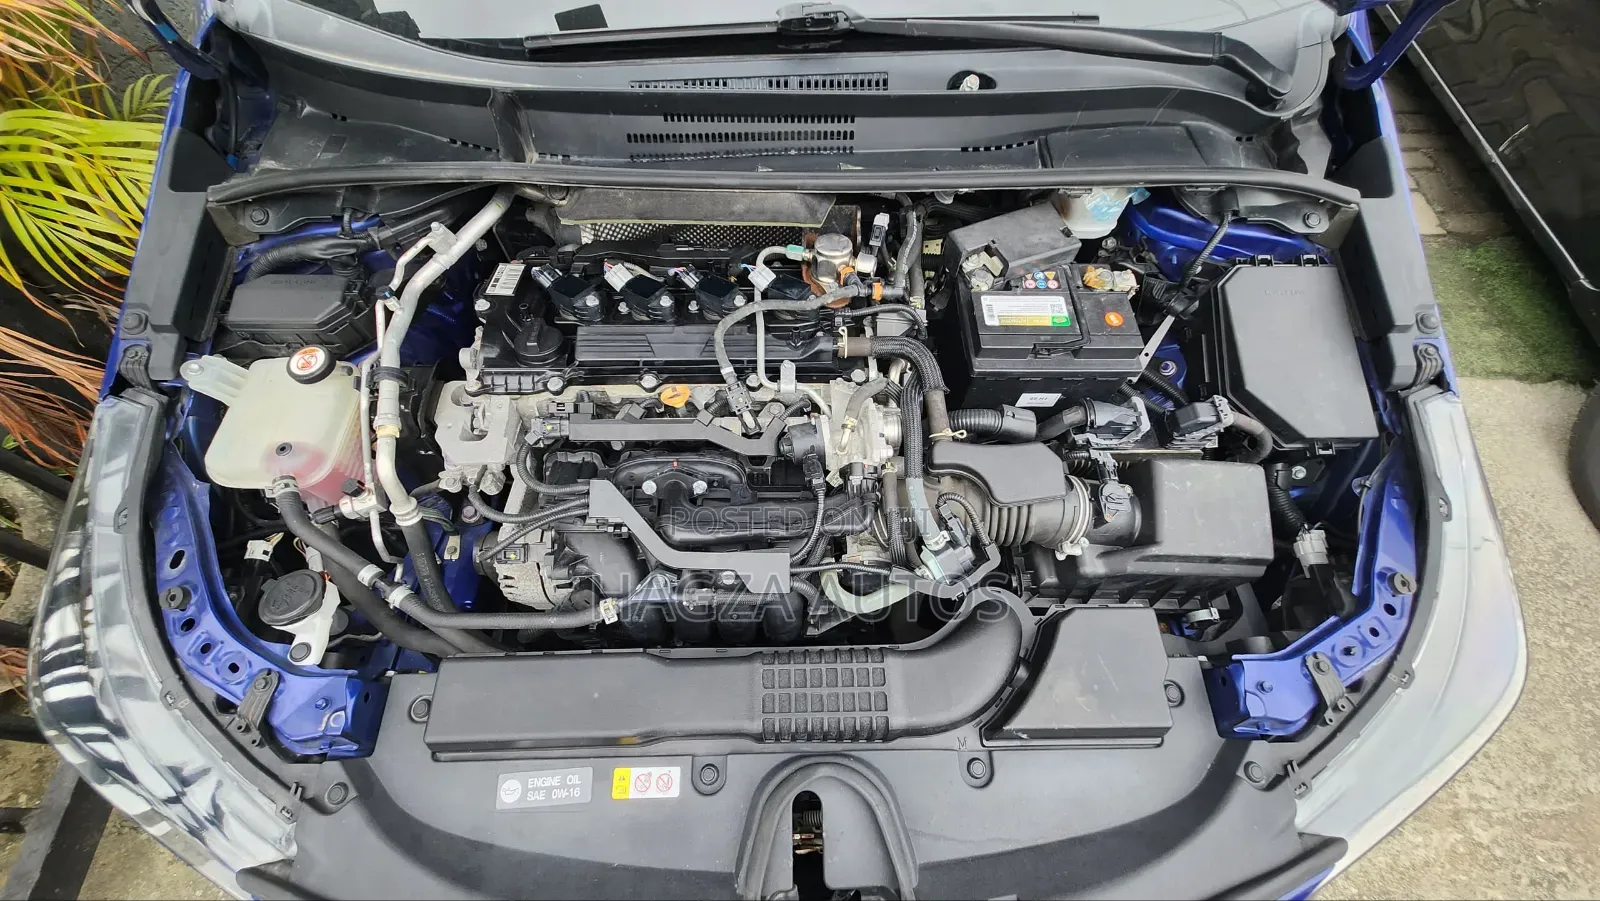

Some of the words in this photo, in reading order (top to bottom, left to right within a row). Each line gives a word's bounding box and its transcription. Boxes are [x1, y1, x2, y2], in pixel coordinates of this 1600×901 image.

[527, 776, 561, 788] ENGINE
[566, 774, 582, 785] OIL
[526, 791, 546, 801] SAE
[551, 787, 581, 799] 0W-16
